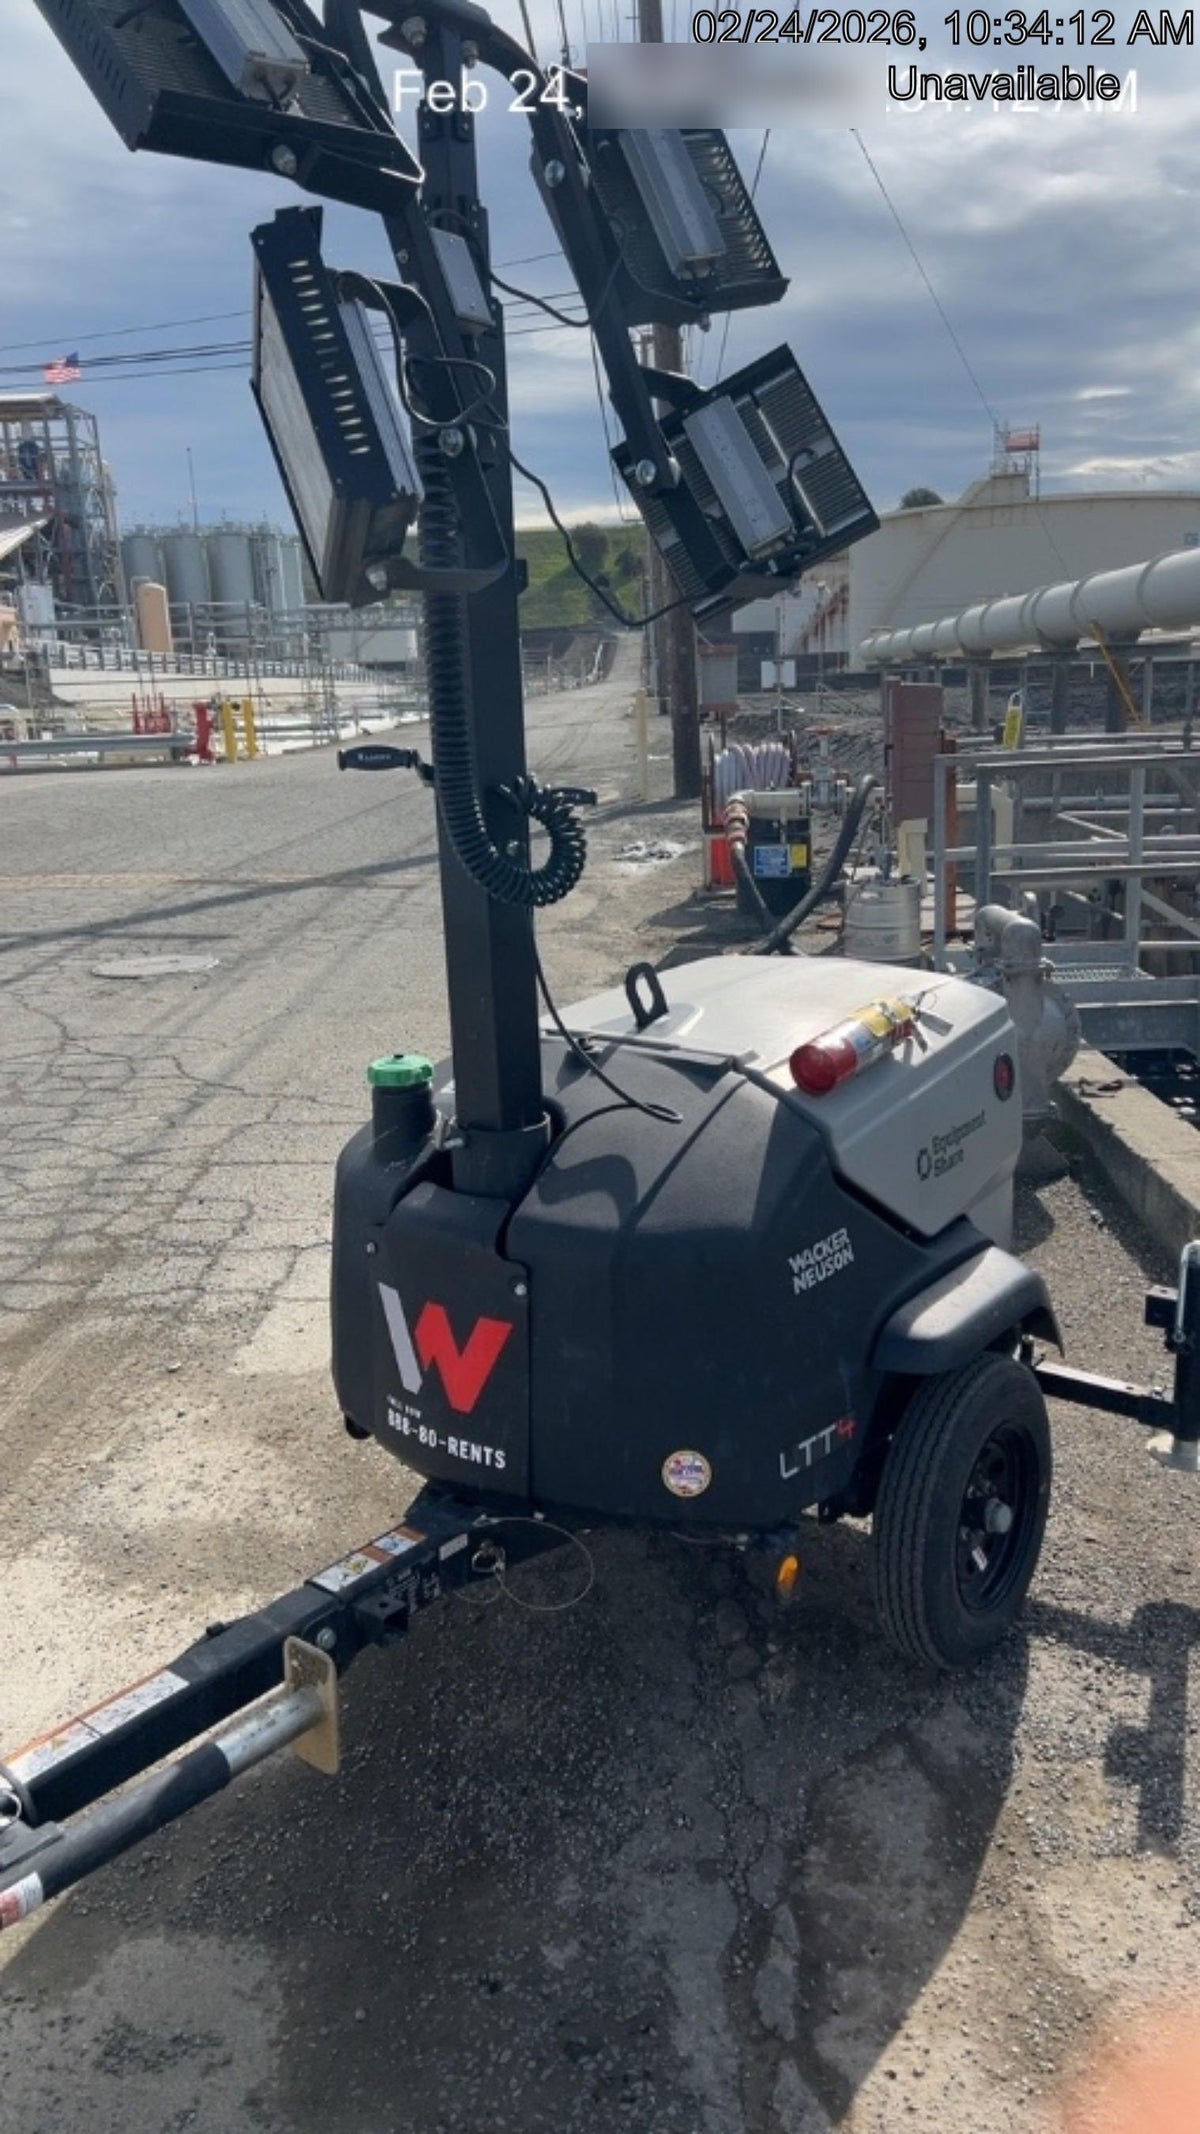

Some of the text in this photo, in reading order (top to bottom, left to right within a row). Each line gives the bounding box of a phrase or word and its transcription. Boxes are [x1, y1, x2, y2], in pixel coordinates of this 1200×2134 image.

[787, 1227, 850, 1274] WACKER
[793, 1244, 854, 1295] NEUSON
[387, 1407, 506, 1469] 888-80-RENTS
